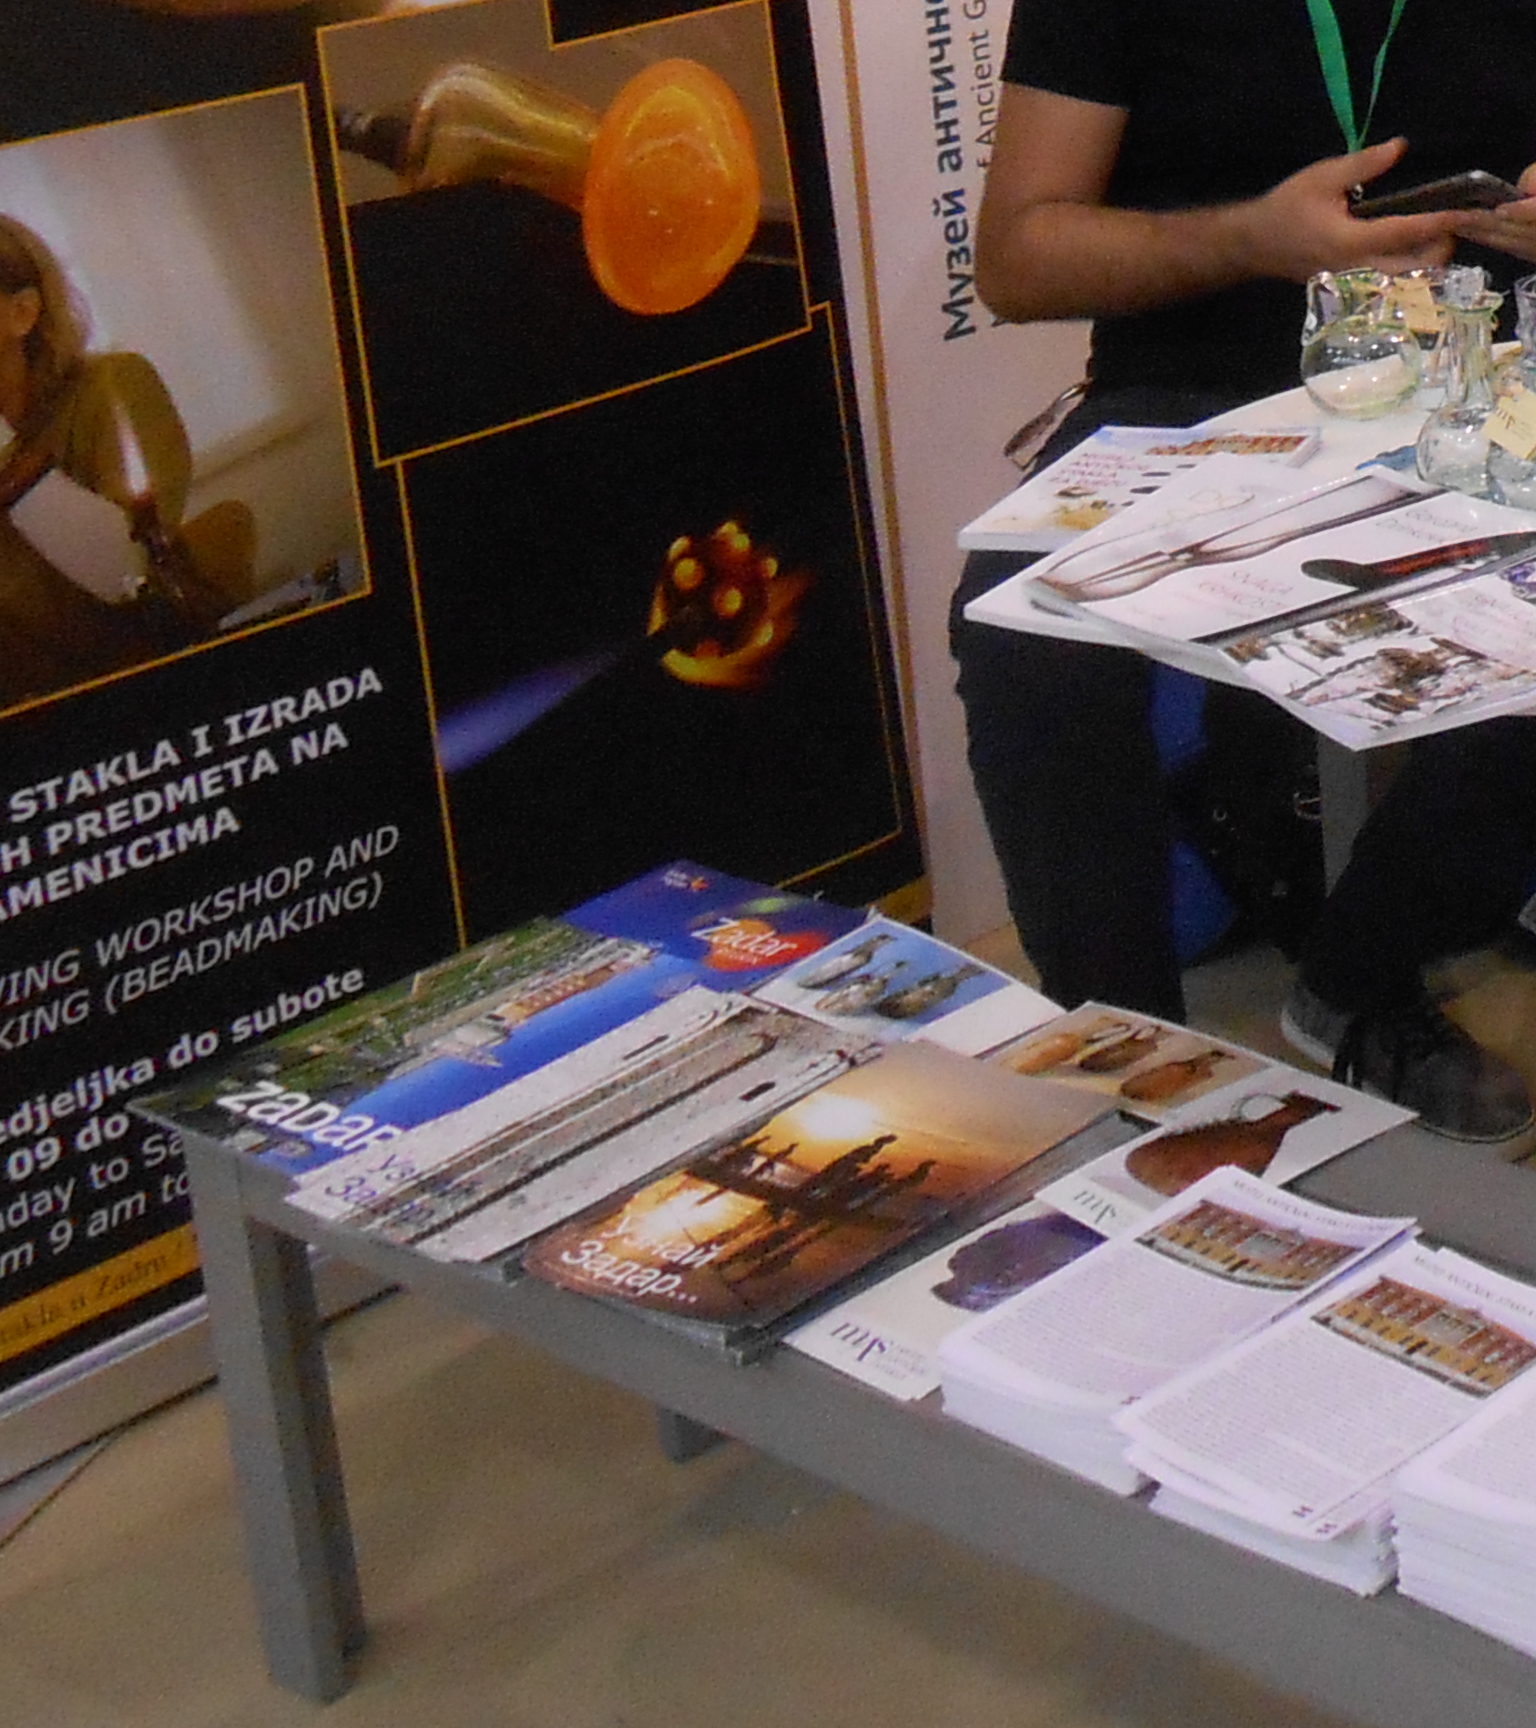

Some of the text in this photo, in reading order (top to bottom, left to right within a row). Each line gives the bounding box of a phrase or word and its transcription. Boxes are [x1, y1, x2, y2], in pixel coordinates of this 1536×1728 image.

[970, 31, 997, 146] Ancient
[932, 187, 976, 341] Музей
[9, 668, 384, 823] STAKLA I IZRADA
[47, 748, 280, 856] PREDMETA
[291, 722, 350, 765] NA
[96, 856, 315, 967] WORKSHOP
[324, 824, 400, 878] AND
[105, 871, 384, 1014] (BEADMAKING)
[690, 916, 798, 959] Zadar
[168, 1028, 219, 1070] do
[231, 968, 365, 1042] subote
[0, 1177, 76, 1232] day
[88, 1156, 130, 1190] to
[6, 1112, 131, 1183] 09 do
[49, 1219, 75, 1256] 9
[87, 1191, 148, 1238] am
[561, 1239, 698, 1303] Задар...
